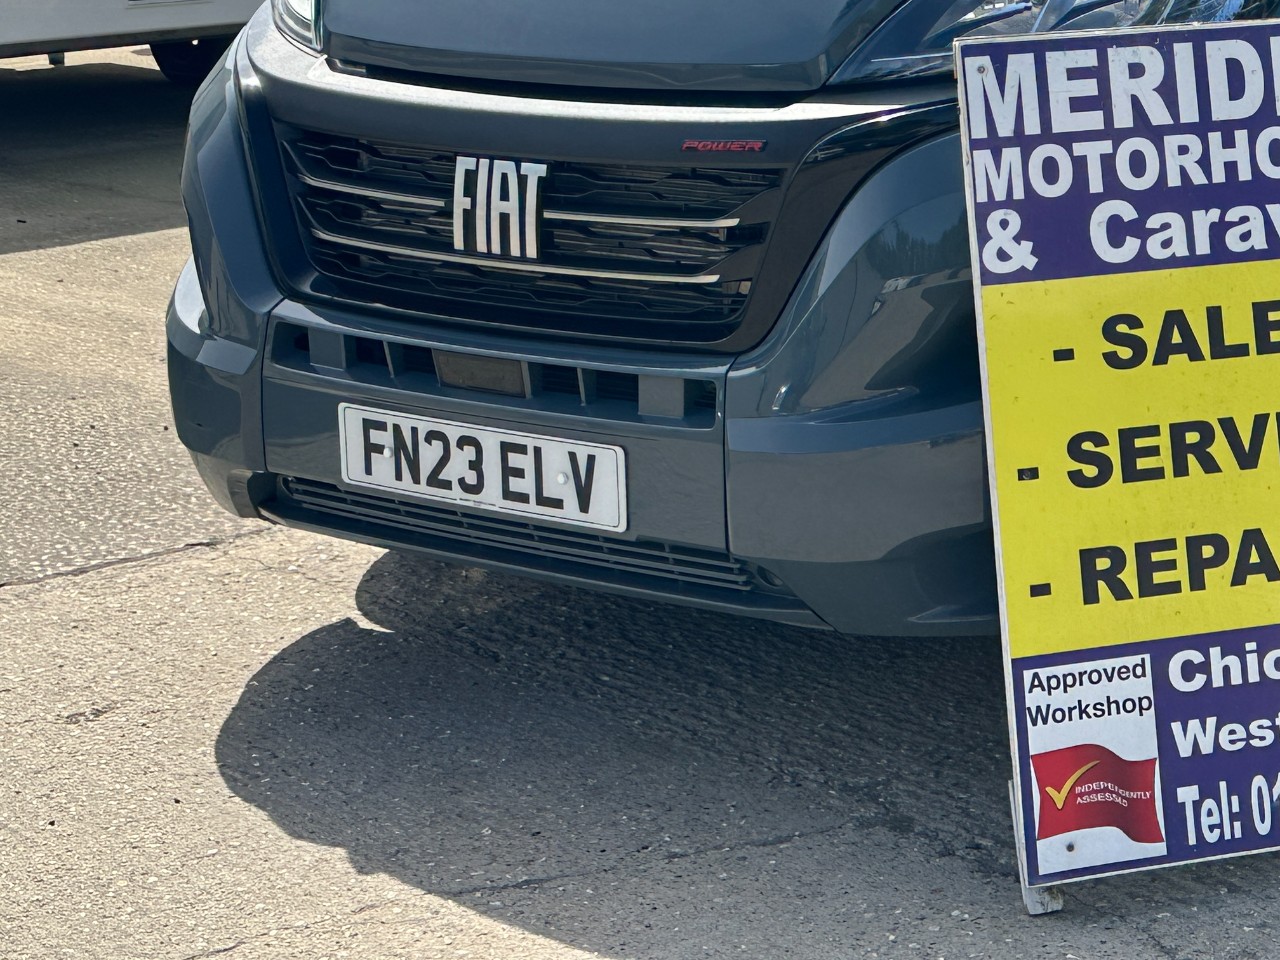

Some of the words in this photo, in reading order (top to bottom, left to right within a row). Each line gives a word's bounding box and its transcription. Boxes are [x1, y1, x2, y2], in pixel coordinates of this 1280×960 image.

[681, 140, 766, 152] POWER
[453, 156, 547, 258] FIAT
[981, 208, 1039, 275] &
[362, 418, 485, 495] FN23
[500, 440, 596, 514] ELV
[1028, 657, 1147, 696] Approved
[1026, 695, 1153, 727] Workshop
[1075, 781, 1152, 800] INDEPENDENTLY
[1076, 792, 1128, 807] ASSESSED
[1176, 780, 1242, 846] Tel:
